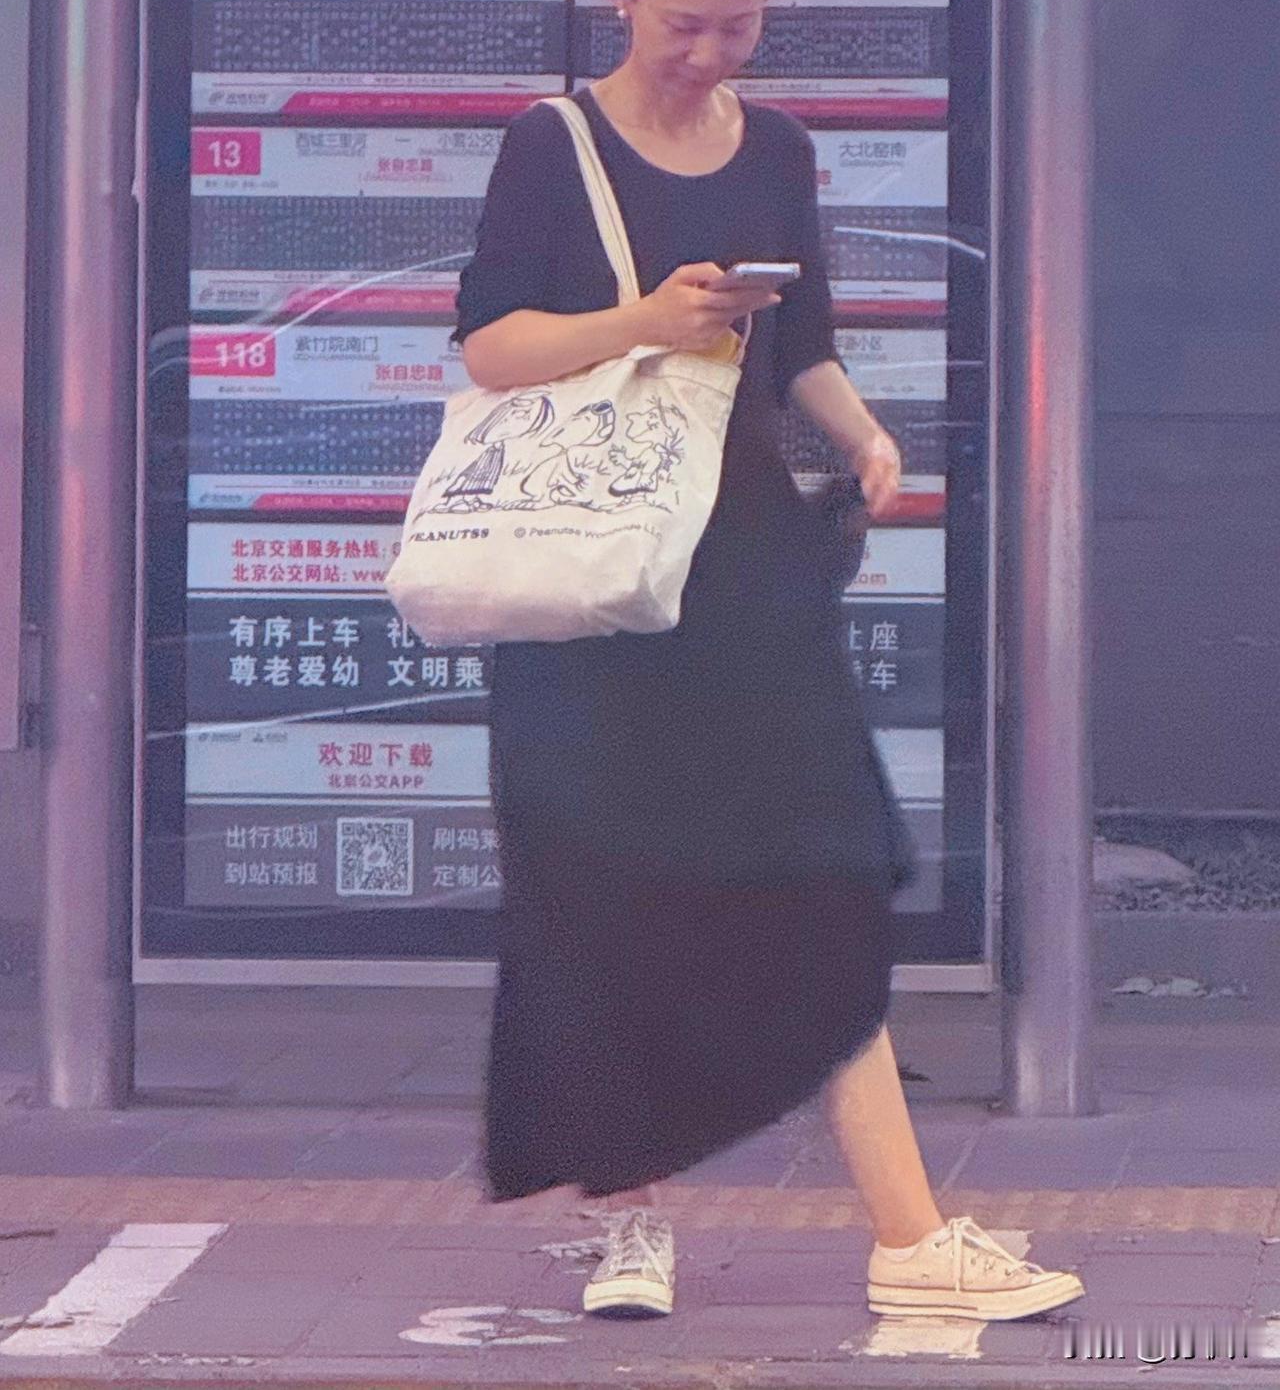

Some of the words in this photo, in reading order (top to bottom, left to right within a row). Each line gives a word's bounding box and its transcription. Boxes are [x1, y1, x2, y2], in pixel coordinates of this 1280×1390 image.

[208, 140, 242, 168] 13
[215, 342, 267, 369] 118
[375, 364, 443, 381] 张自忠路
[229, 616, 360, 648] 有序上车
[229, 656, 360, 687] 尊老爱幼
[387, 656, 484, 688] 文明乘
[319, 742, 434, 768] 欢迎下载
[328, 774, 425, 790] 北京公交APP
[225, 825, 319, 850] 出行规划
[224, 862, 319, 886] 到站预报
